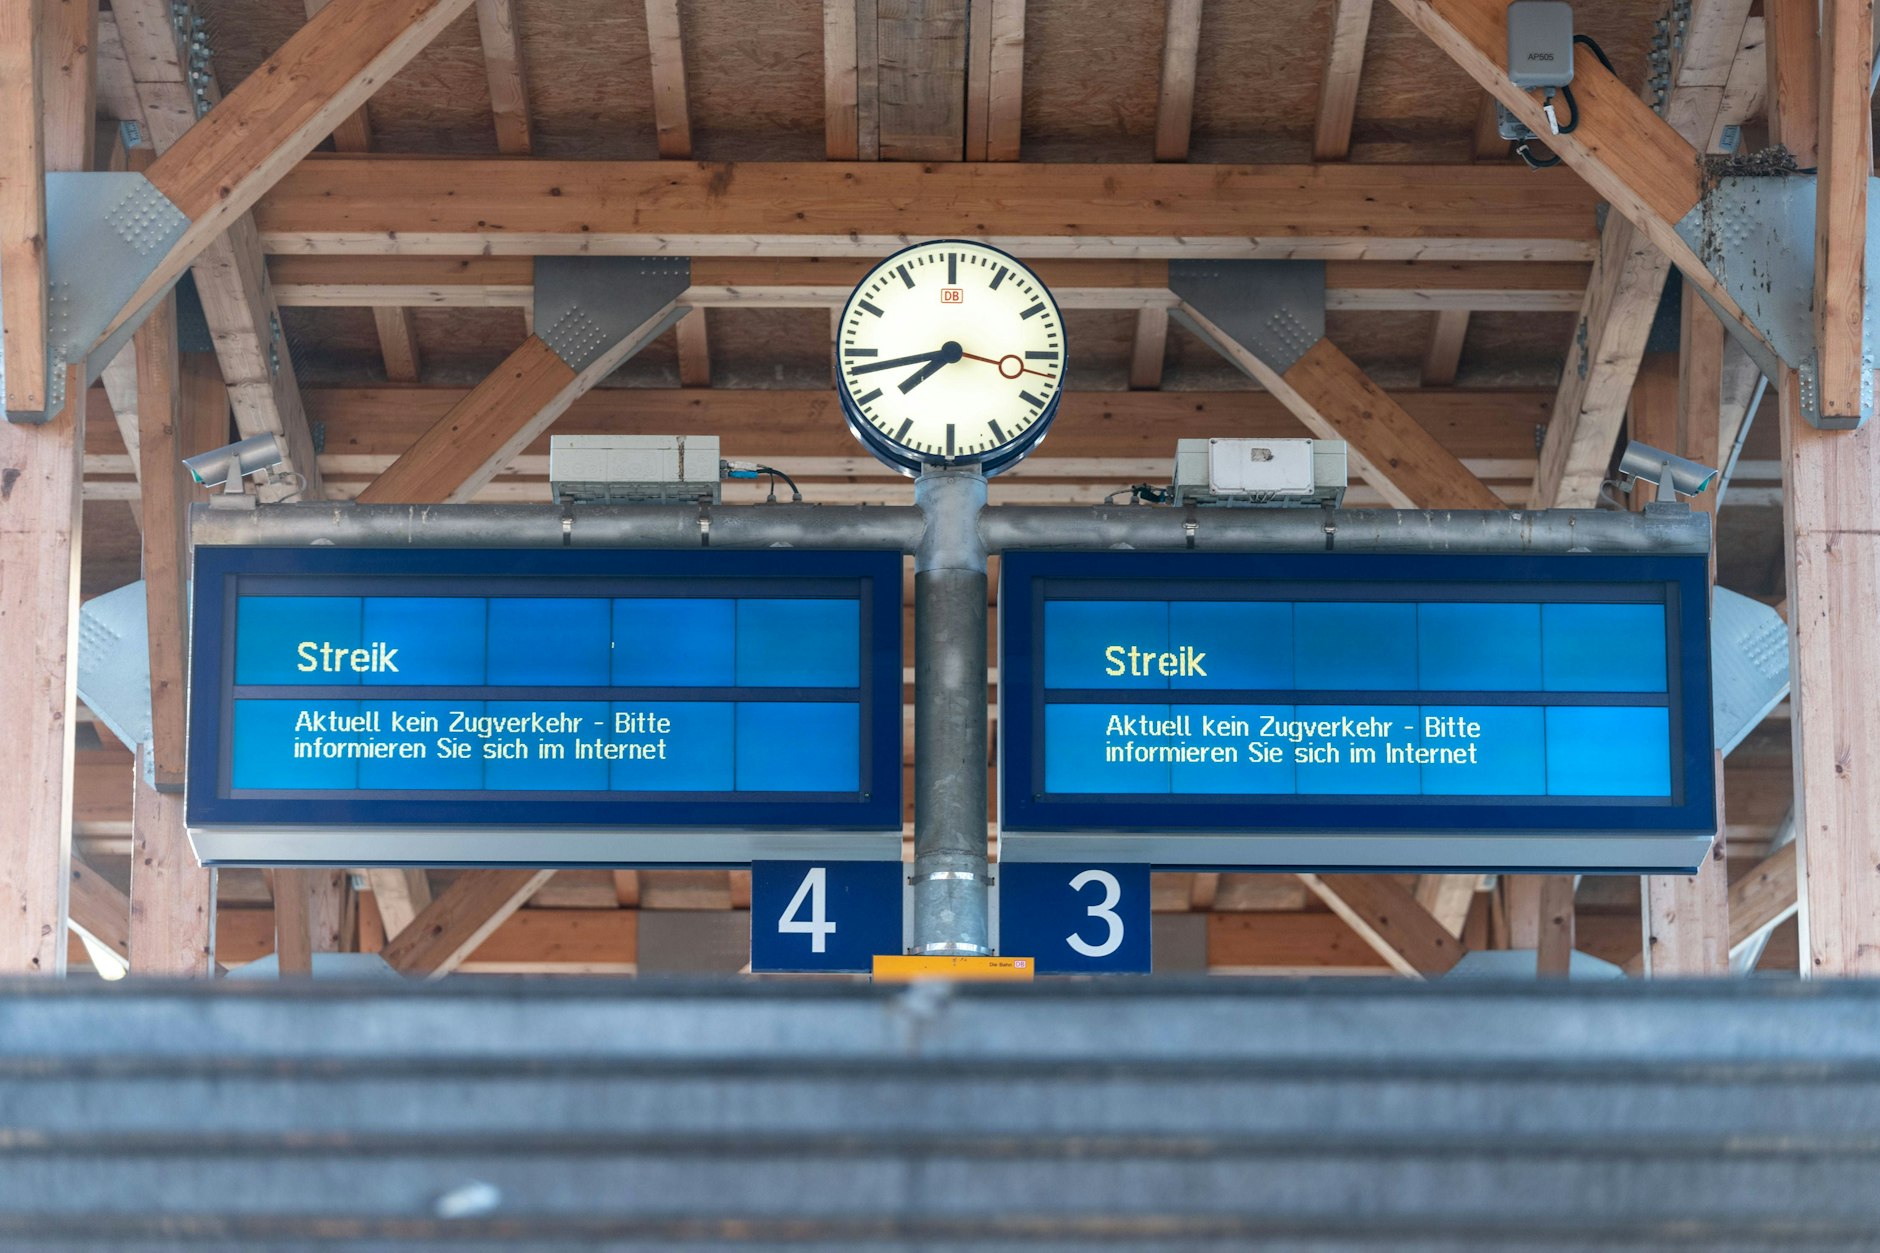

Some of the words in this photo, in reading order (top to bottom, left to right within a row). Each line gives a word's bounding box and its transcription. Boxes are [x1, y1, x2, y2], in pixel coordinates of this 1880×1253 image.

[1527, 53, 1554, 61] AP505
[944, 290, 960, 301] DB
[297, 642, 399, 672] Streik
[1105, 646, 1207, 676] Streik
[295, 710, 380, 732] Aktuell
[391, 711, 439, 732] kein
[449, 711, 583, 738] Zugverkehr
[615, 712, 671, 733] Bitte
[1106, 714, 1192, 737] Aktuell
[1202, 715, 1249, 737] kein
[1259, 715, 1393, 743] Zugverkehr
[1425, 716, 1481, 738] Bitte
[294, 738, 426, 759] informieren
[437, 737, 472, 759] Sie
[483, 738, 529, 759] sich
[538, 738, 565, 759] im
[575, 738, 667, 760] Internet
[1106, 742, 1238, 763] informieren
[1248, 742, 1283, 763] Sie
[1294, 742, 1340, 763] sich
[1350, 742, 1376, 764] im
[1386, 742, 1477, 764] Internet
[778, 867, 837, 953] 4
[1065, 869, 1125, 957] 3
